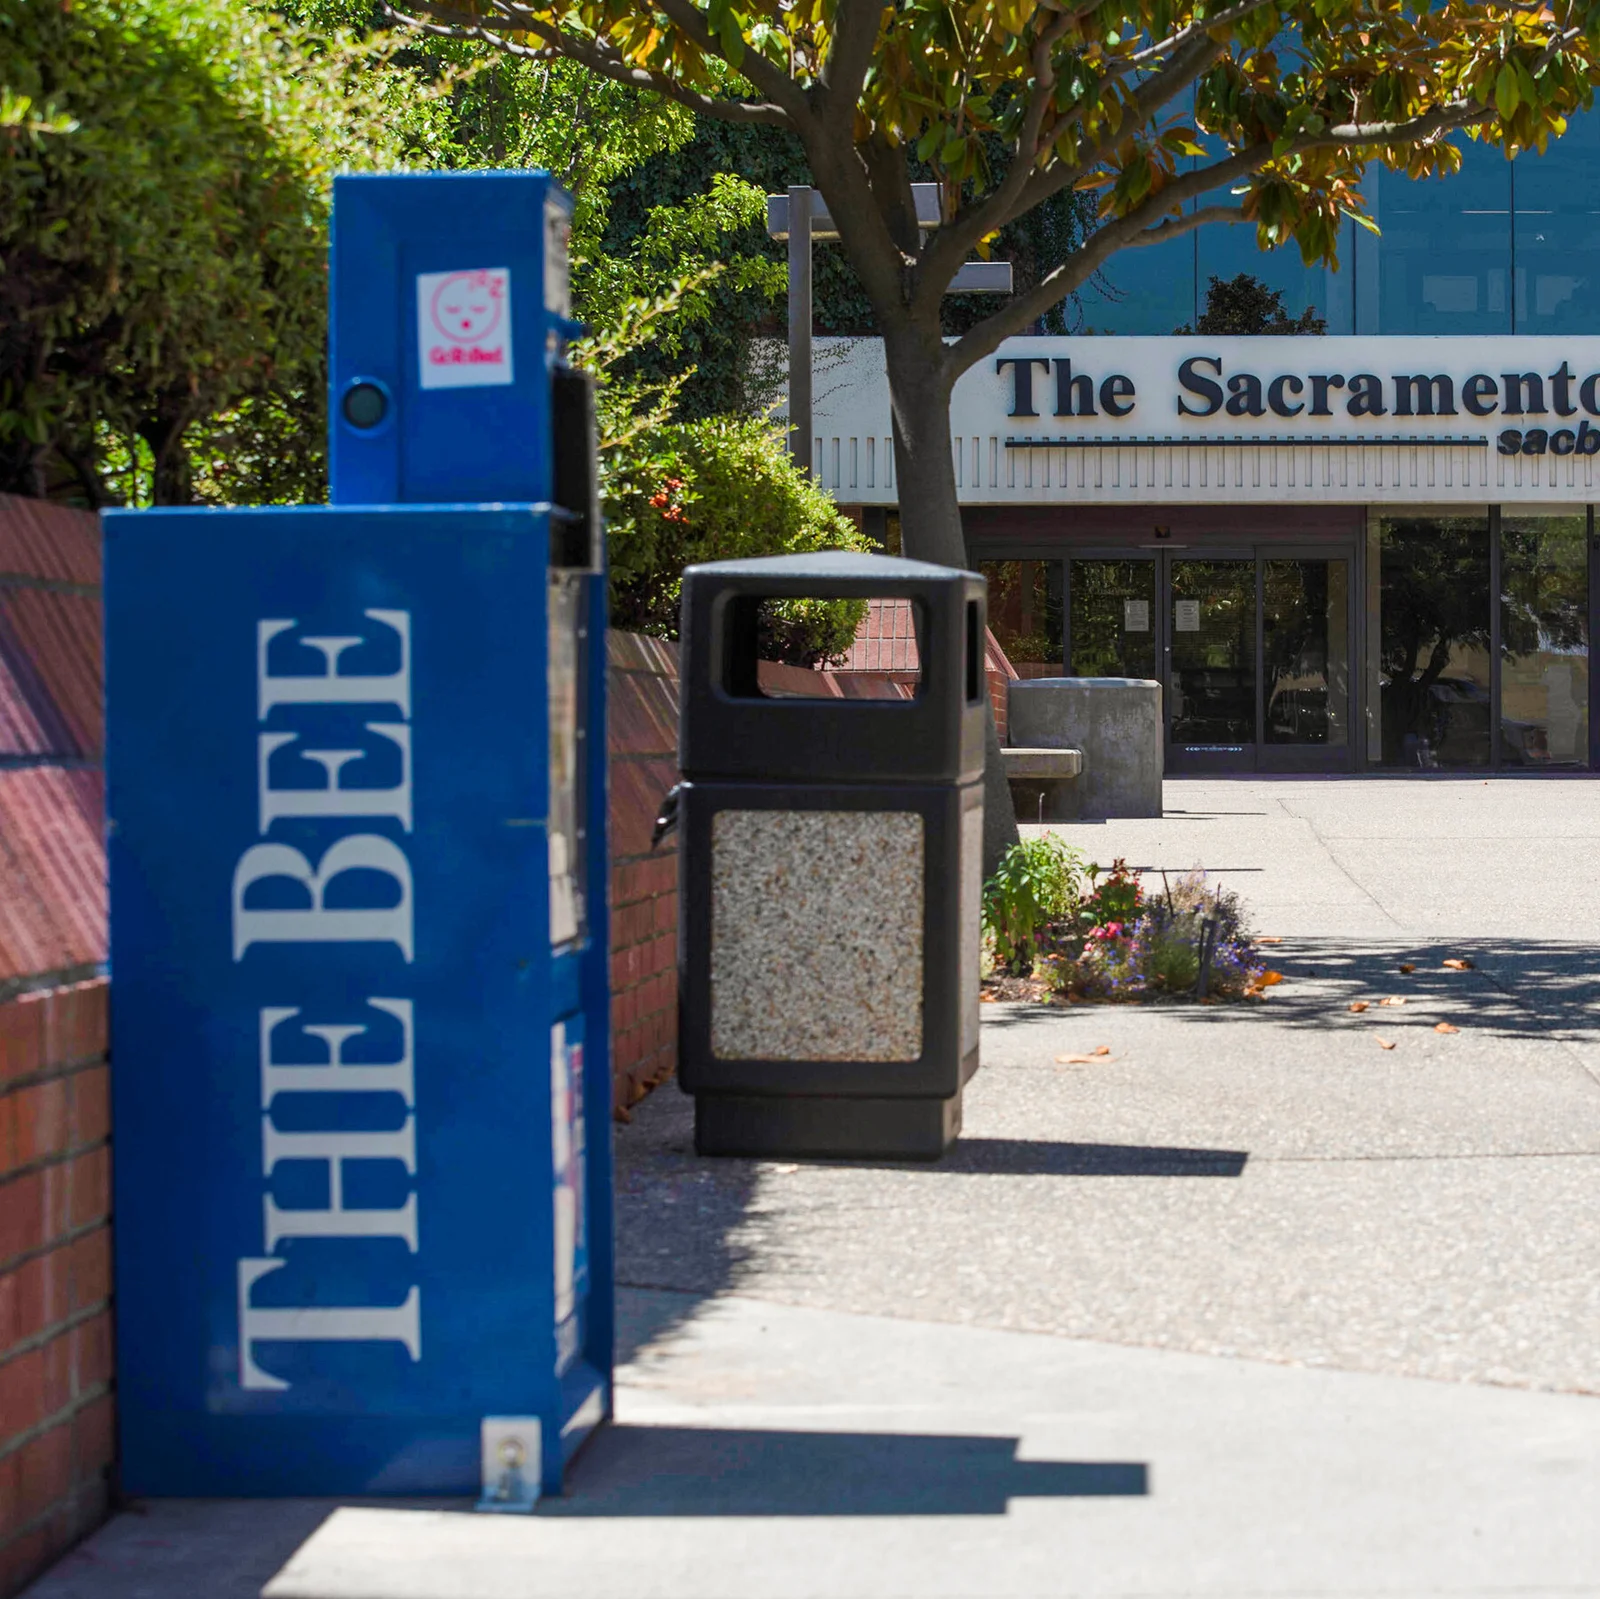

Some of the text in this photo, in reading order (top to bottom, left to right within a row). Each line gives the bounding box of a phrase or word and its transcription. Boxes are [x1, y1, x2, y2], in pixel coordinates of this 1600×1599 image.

[995, 356, 1136, 418] The
[234, 608, 420, 1390] THE BEE
